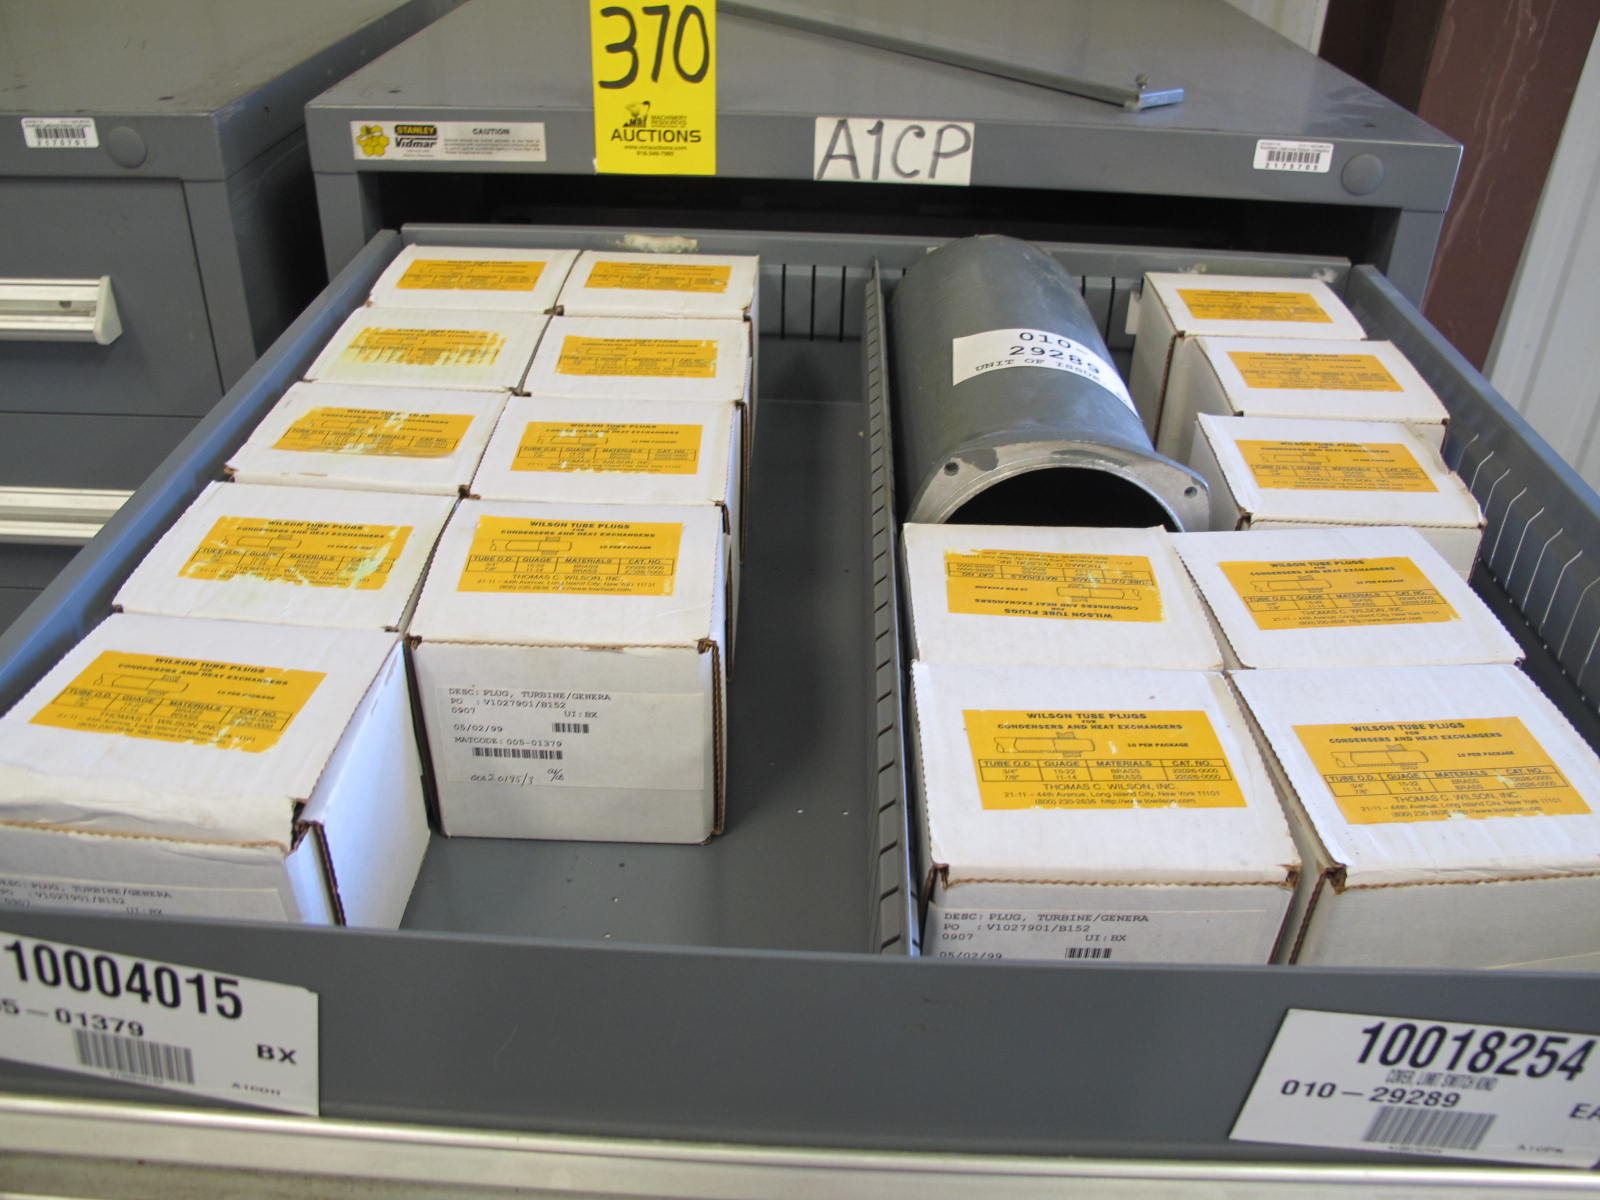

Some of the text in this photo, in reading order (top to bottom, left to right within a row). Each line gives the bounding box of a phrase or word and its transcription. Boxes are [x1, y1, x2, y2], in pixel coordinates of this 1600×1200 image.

[599, 5, 710, 89] 370
[397, 126, 435, 135] STANLEY
[611, 129, 701, 143] AUCTIONS
[395, 138, 436, 148] Vidmar
[817, 119, 970, 181] A1CP
[1009, 345, 1100, 374] 29289
[976, 360, 1014, 372] UNIT
[154, 657, 198, 666] WILSON
[521, 691, 611, 701] TURBINE/GENERA
[453, 723, 503, 732] 05/02/99
[1328, 736, 1392, 744] CONDENSERS
[1433, 769, 1488, 778] MATERIALS
[1393, 795, 1439, 803] THOMAS
[944, 913, 1149, 923] DESC: PLUG, TURBINE/GENERA
[987, 924, 1090, 933] V1027901/B152
[5, 940, 243, 1020] 10004015
[256, 1044, 297, 1065] BX
[1358, 1021, 1596, 1081] 10018254
